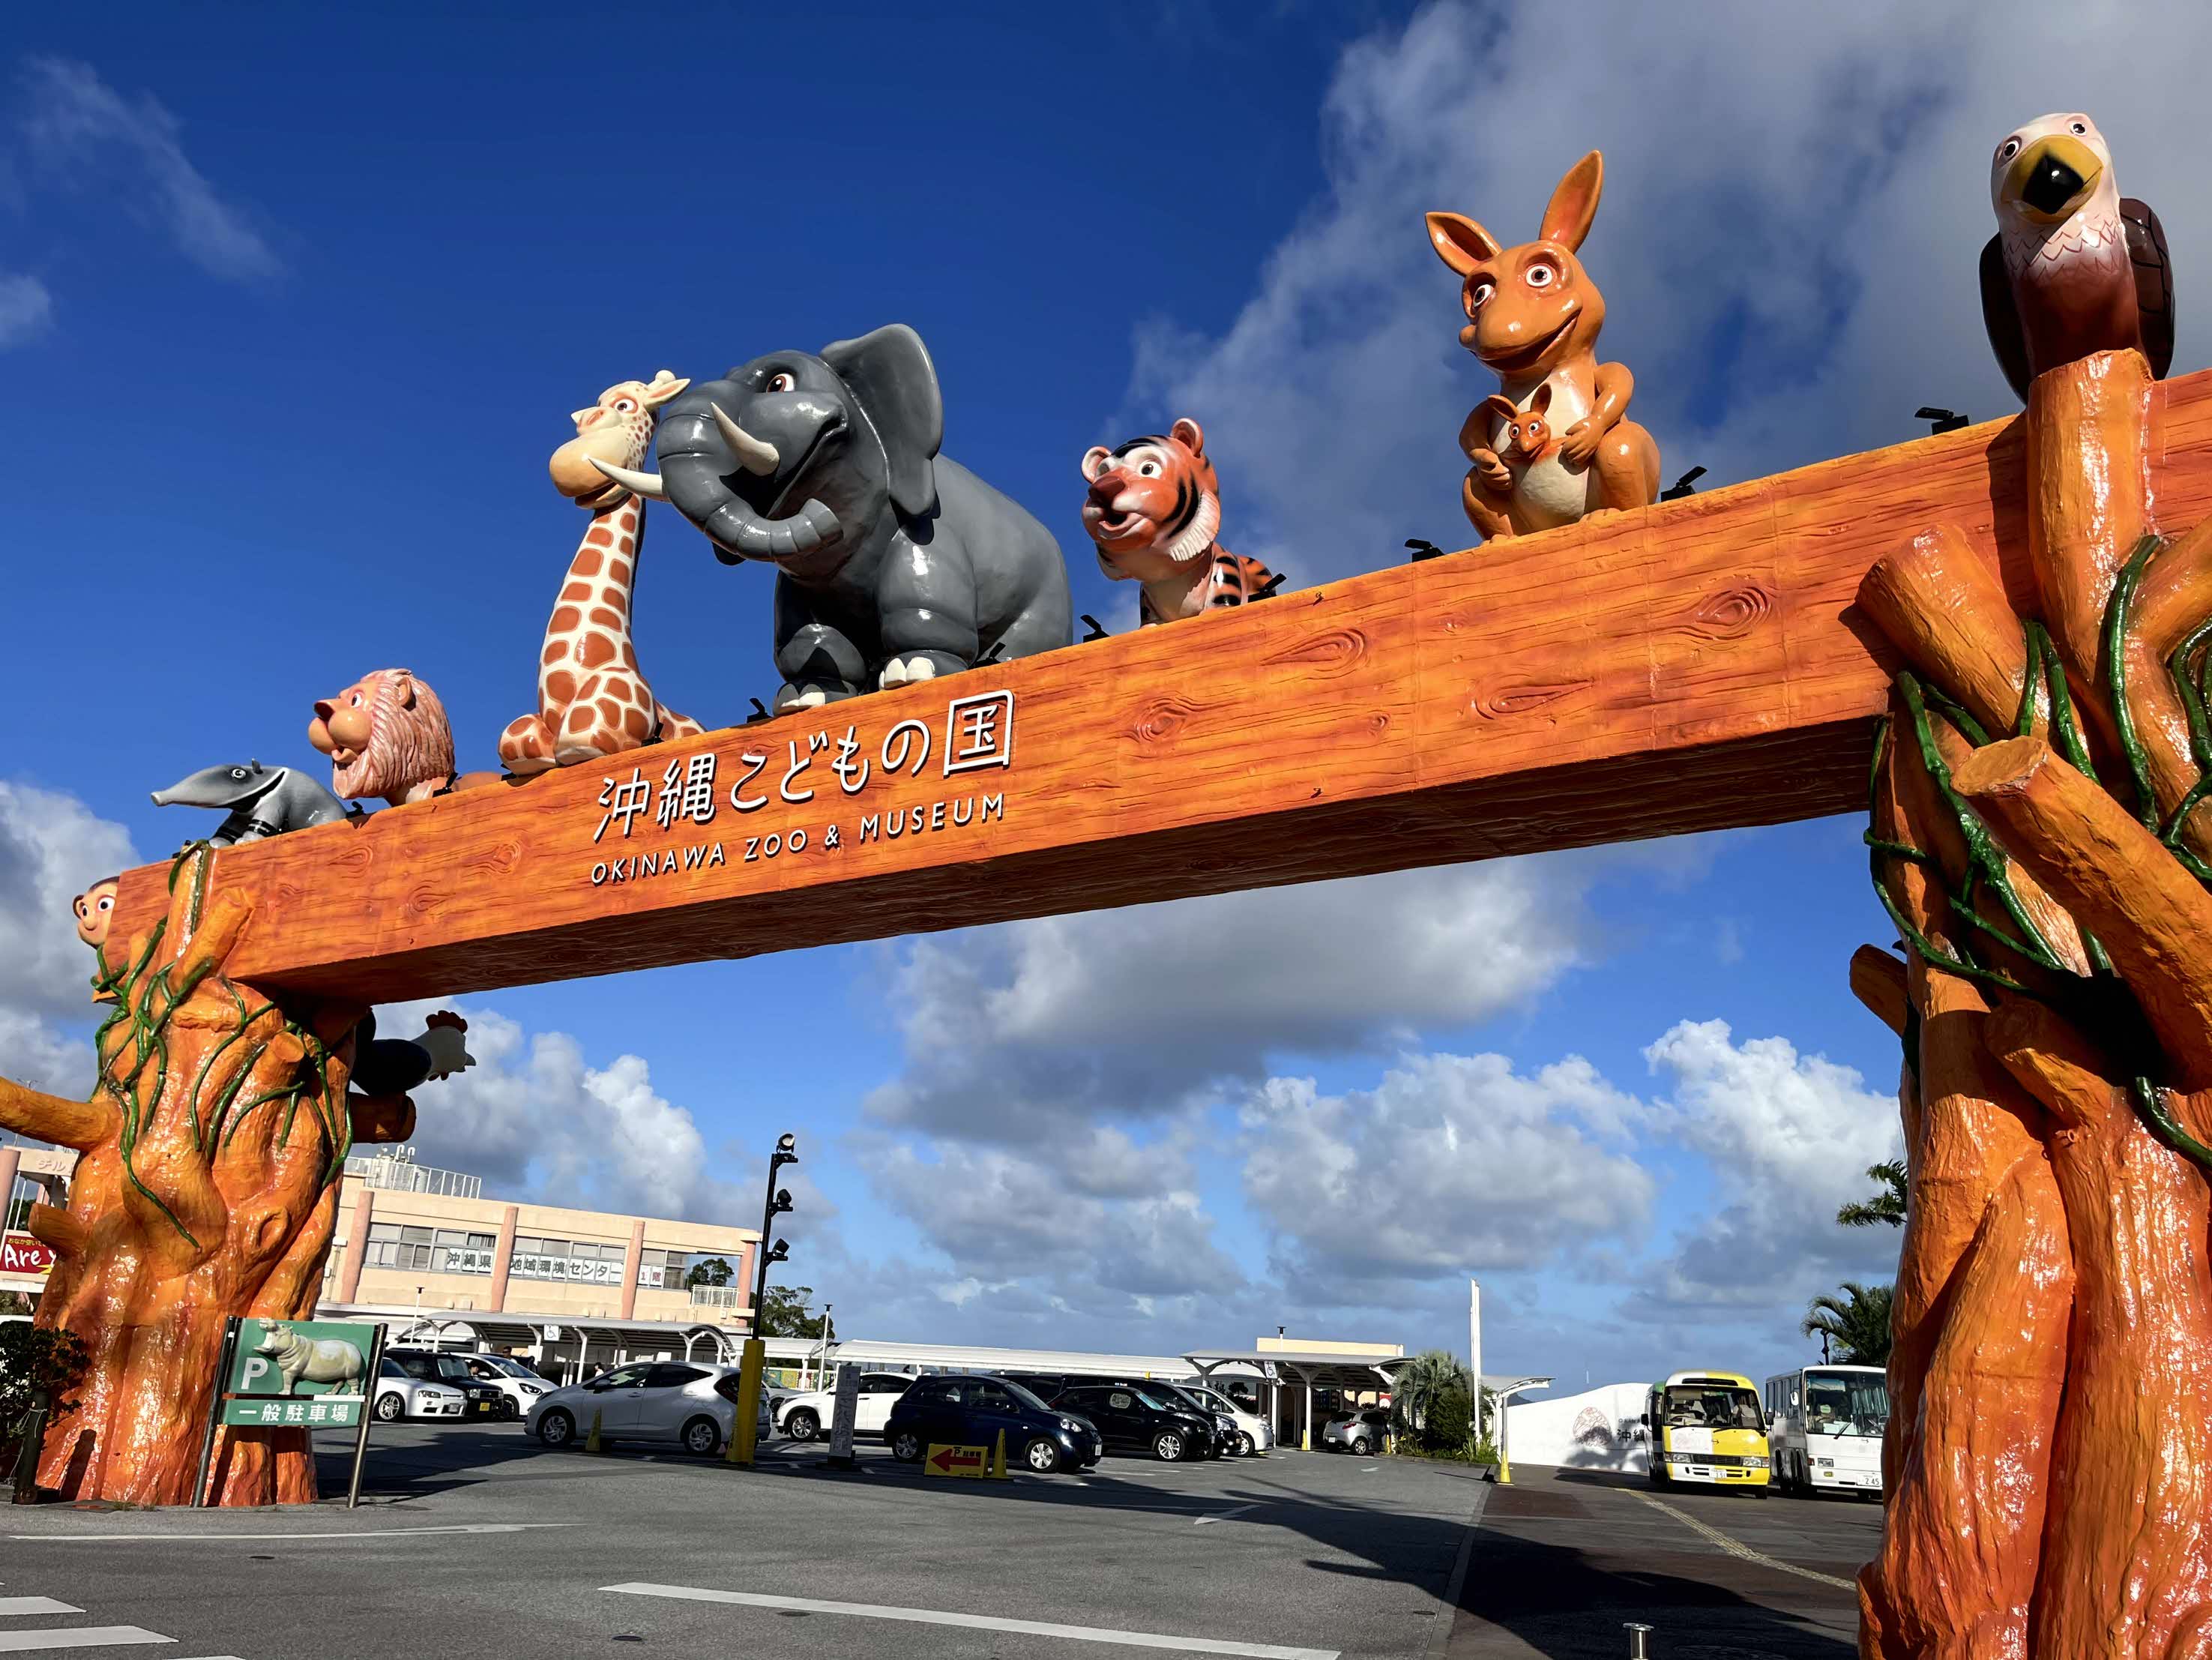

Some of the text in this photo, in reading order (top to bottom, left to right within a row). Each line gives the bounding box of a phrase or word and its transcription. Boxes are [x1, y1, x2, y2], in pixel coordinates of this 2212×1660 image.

[592, 689, 1015, 842] 沖縄こどもの国
[591, 793, 1005, 885] OKINAWA ZOO & MUSEUM
[37, 1158, 75, 1174] チル
[4, 1243, 41, 1269] Are
[447, 1252, 492, 1268] 沖縄県
[241, 1357, 268, 1390] P
[238, 1403, 349, 1422] 一般駐車場
